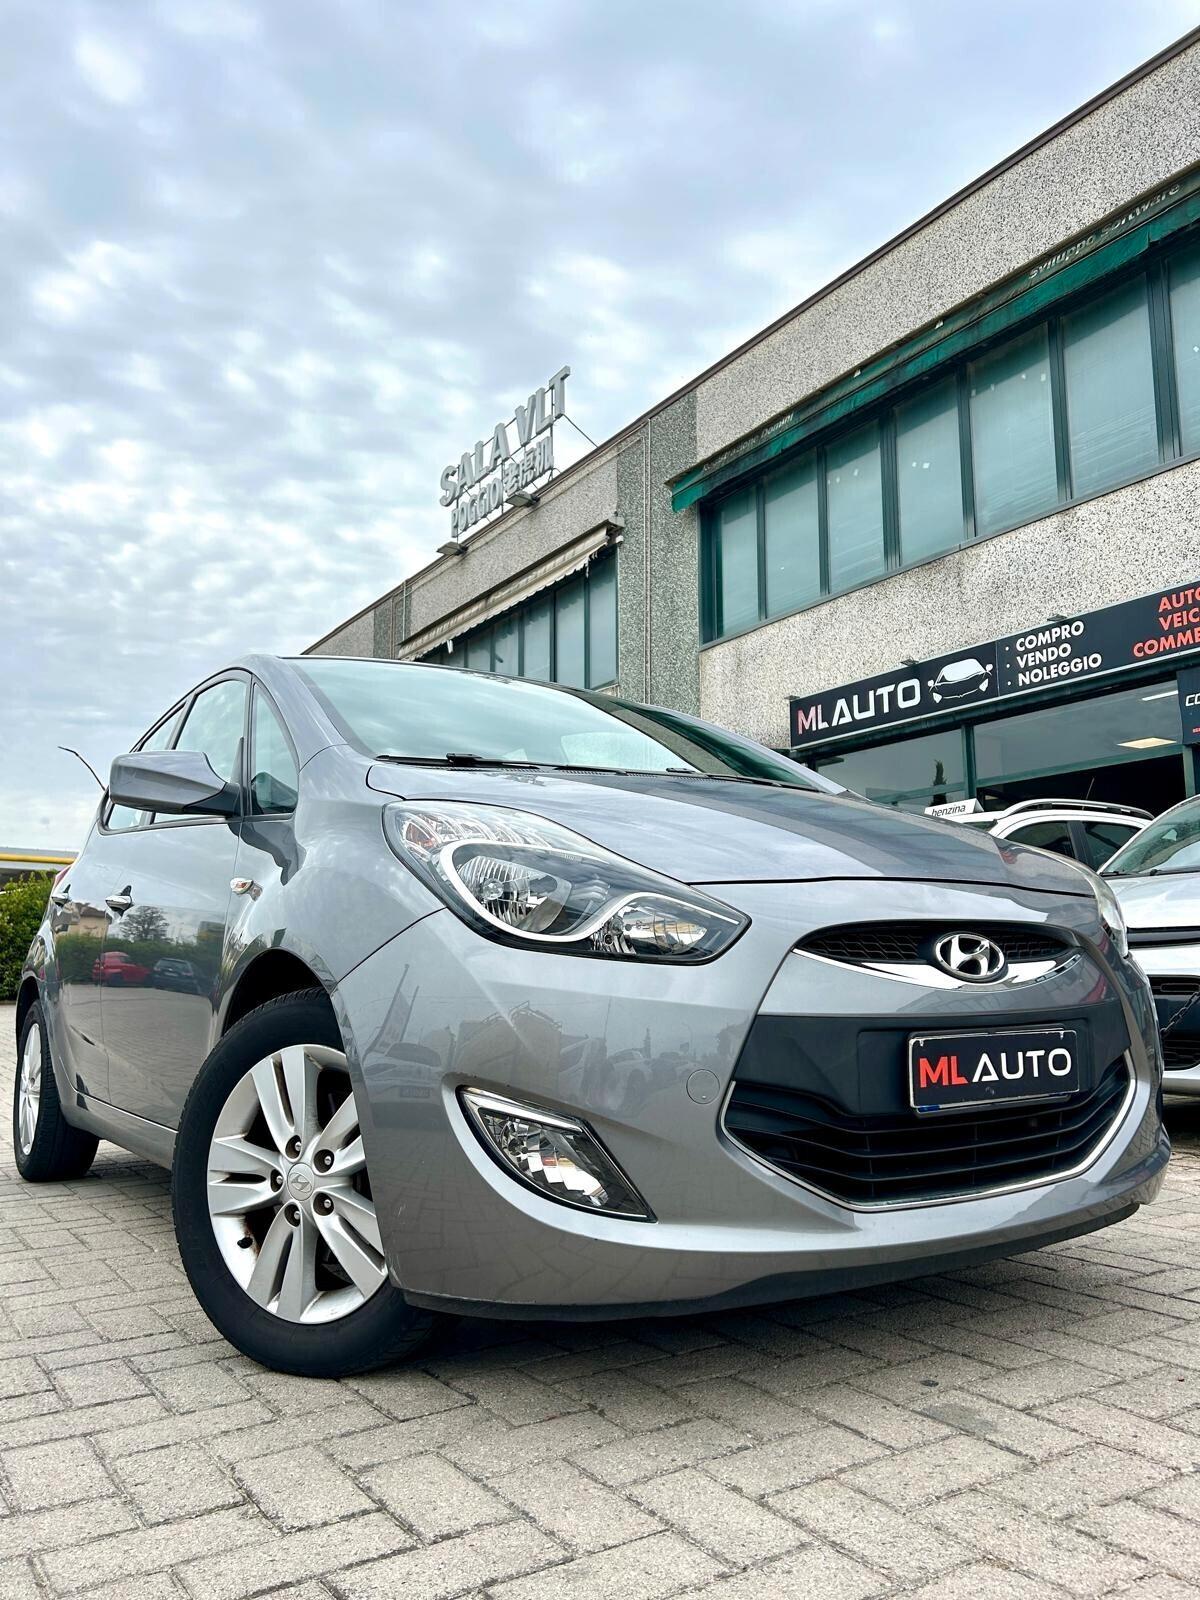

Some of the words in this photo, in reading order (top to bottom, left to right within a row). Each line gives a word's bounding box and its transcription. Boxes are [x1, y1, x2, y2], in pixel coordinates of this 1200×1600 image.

[439, 423, 511, 507] SALA
[515, 365, 571, 447] VLT
[451, 478, 503, 538] POGGIO
[1015, 621, 1084, 652] COMPRO
[1158, 607, 1200, 631] VEIC
[1016, 643, 1072, 669] VENDO
[1017, 653, 1102, 687] NOLEGGIO
[831, 678, 921, 726] AUTO
[919, 1055, 968, 1088] ML
[971, 1047, 1072, 1083] AUTO
